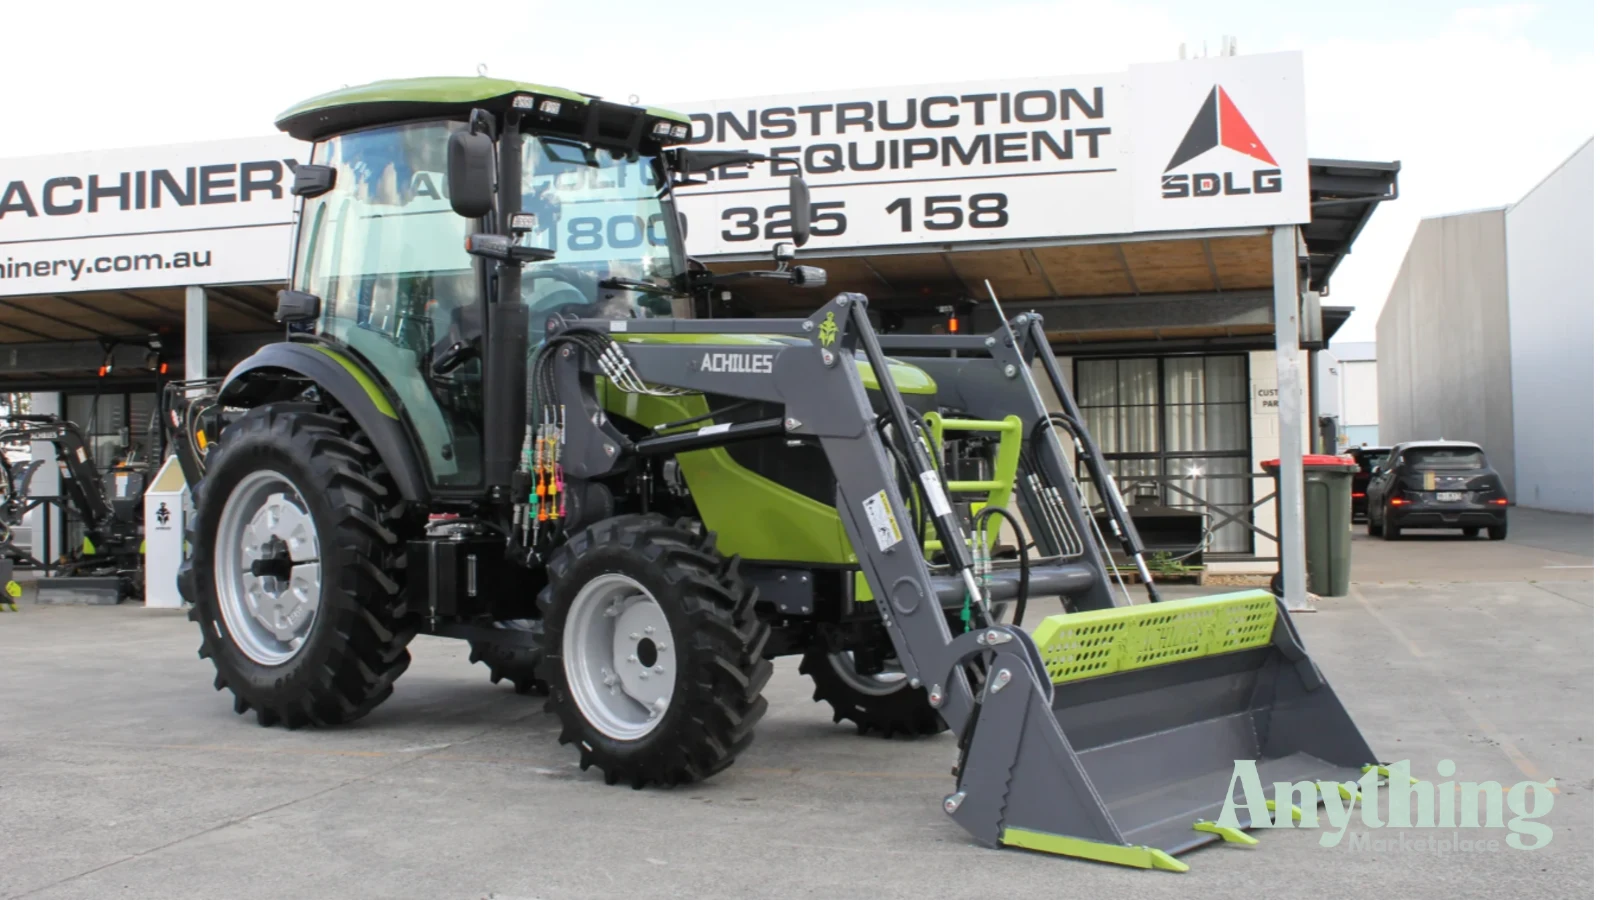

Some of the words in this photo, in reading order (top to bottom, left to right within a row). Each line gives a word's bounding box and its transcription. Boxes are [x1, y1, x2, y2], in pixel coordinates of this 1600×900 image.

[687, 87, 1104, 143] ONSTRUCTION
[770, 127, 1111, 177] EQUIPMENT
[0, 159, 299, 219] ACHINER
[1160, 168, 1282, 198] SDLG
[721, 201, 847, 242] 325
[885, 192, 1009, 232] 158
[701, 353, 773, 374] ACHILLES
